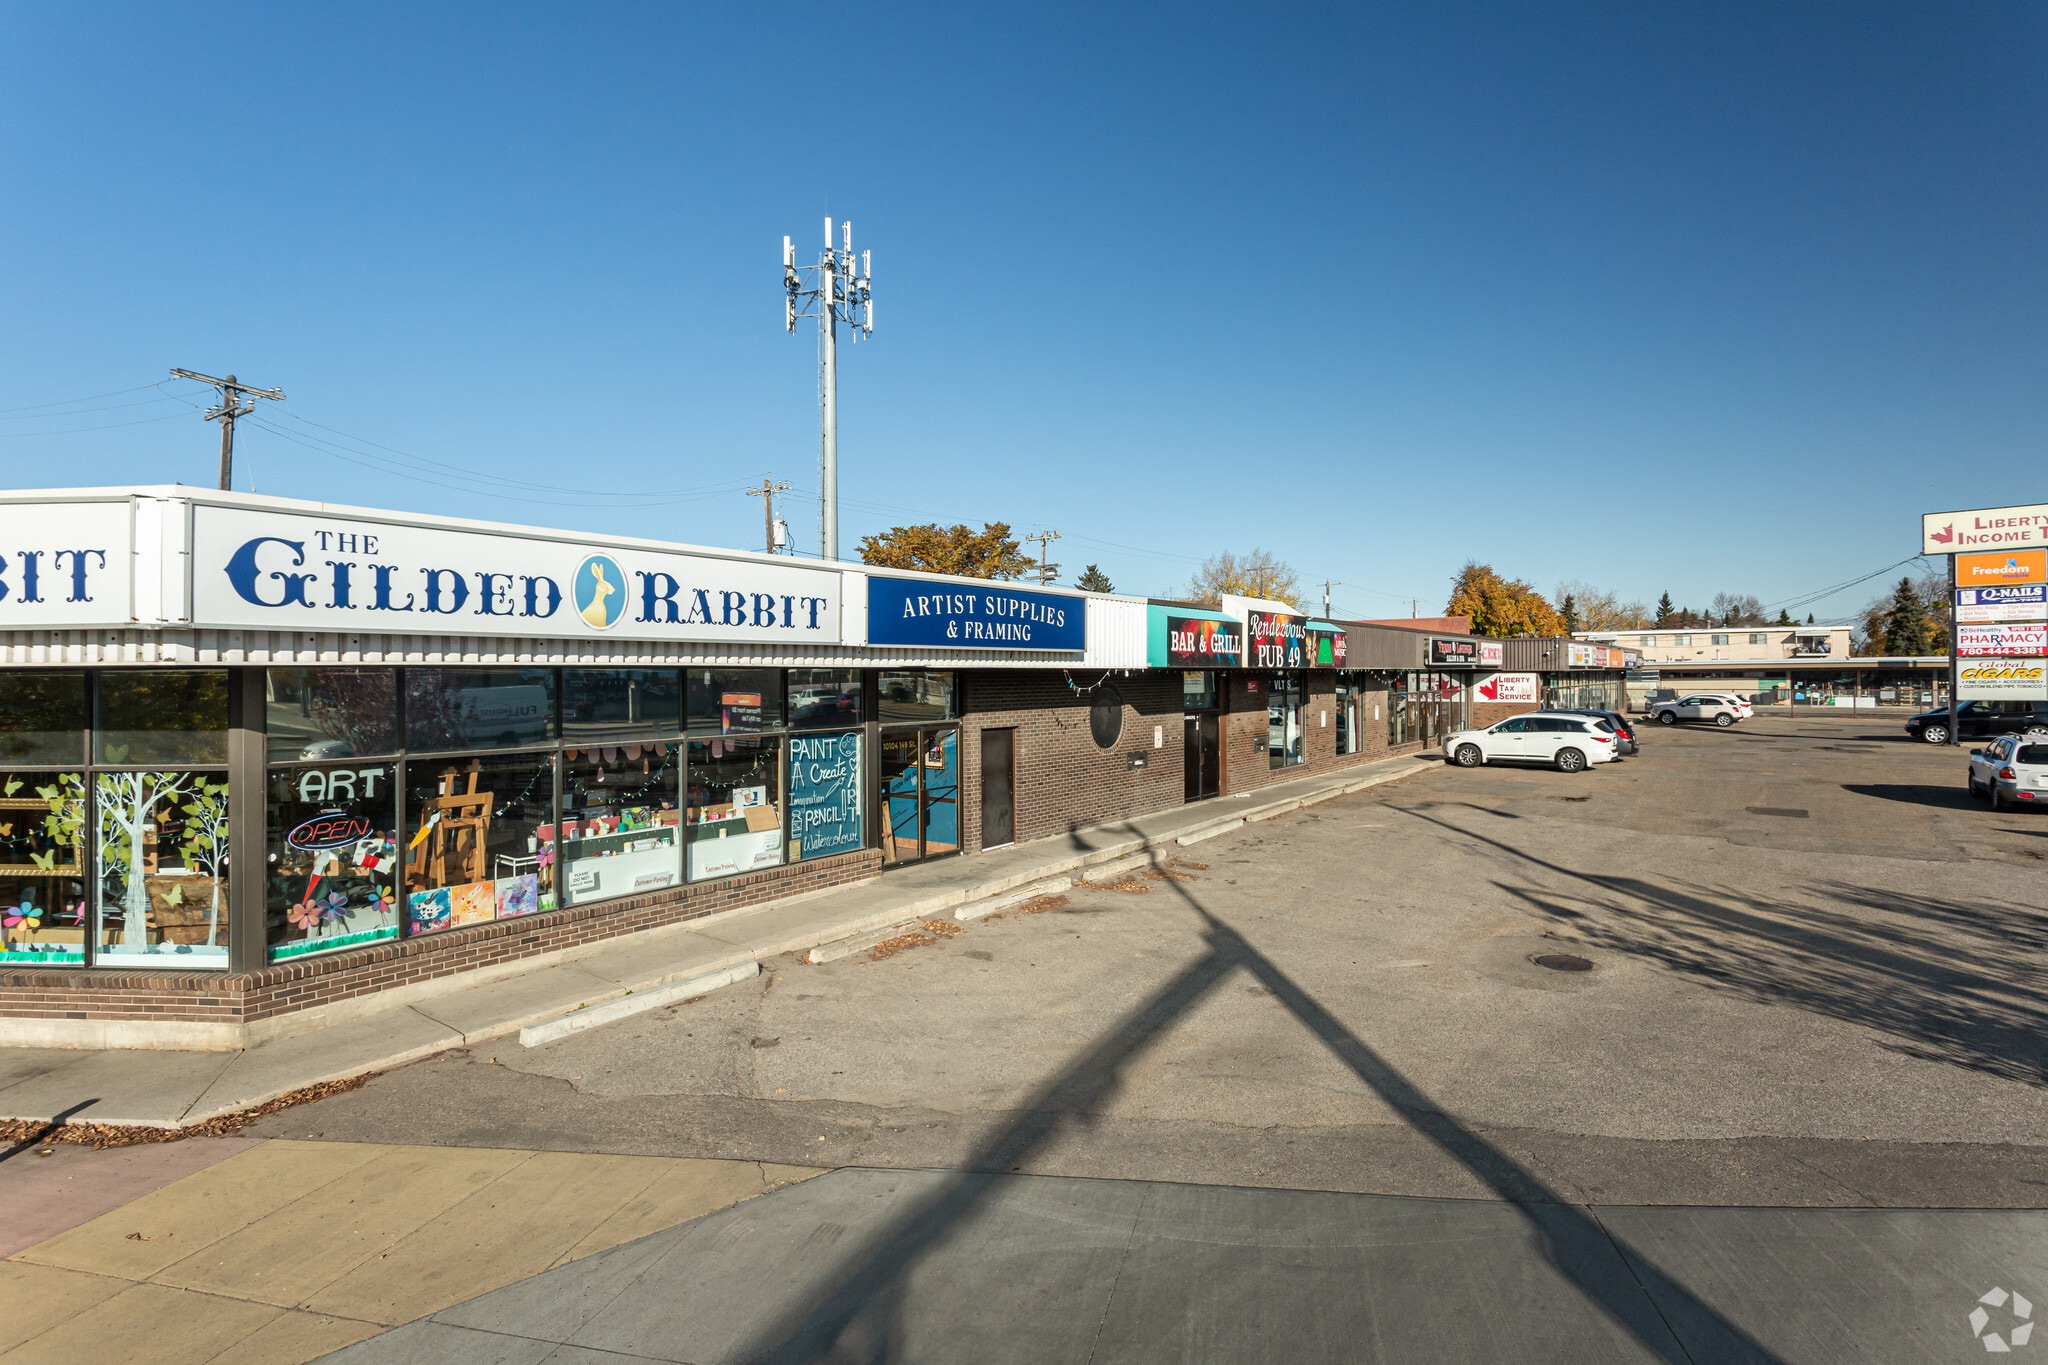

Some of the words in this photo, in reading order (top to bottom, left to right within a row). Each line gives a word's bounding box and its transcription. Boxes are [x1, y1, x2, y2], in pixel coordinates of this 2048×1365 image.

[315, 530, 379, 555] THE
[1958, 531, 2031, 545] INCOME
[0, 549, 106, 604] IT
[1972, 565, 2029, 576] Freedom
[224, 537, 563, 619] GILDED
[635, 570, 827, 630] RABBIT
[1981, 587, 2043, 601] Q-NAILS
[903, 594, 977, 618] ARTIST
[985, 596, 1065, 628] SUPPLIES
[946, 620, 958, 638] &
[964, 621, 1031, 641] FRAMING
[1250, 613, 1306, 640] Rendezvous
[1171, 630, 1195, 652] BAR
[1199, 634, 1207, 653] &
[1211, 633, 1241, 654] GRILL
[1960, 633, 2043, 646] PHARMACY
[1258, 645, 1283, 668] PUB
[1288, 647, 1300, 668] 49
[1961, 668, 2044, 679] CIGARS
[789, 738, 837, 762] PAINT
[810, 757, 847, 783] Create
[300, 768, 384, 802] ART
[847, 772, 857, 822] ART
[788, 790, 825, 813] Imagination
[291, 818, 370, 843] OPEN
[805, 806, 842, 832] PENCIL
[803, 824, 858, 851] Watercolour
[635, 879, 653, 887] Customer
[653, 876, 668, 884] Parking
